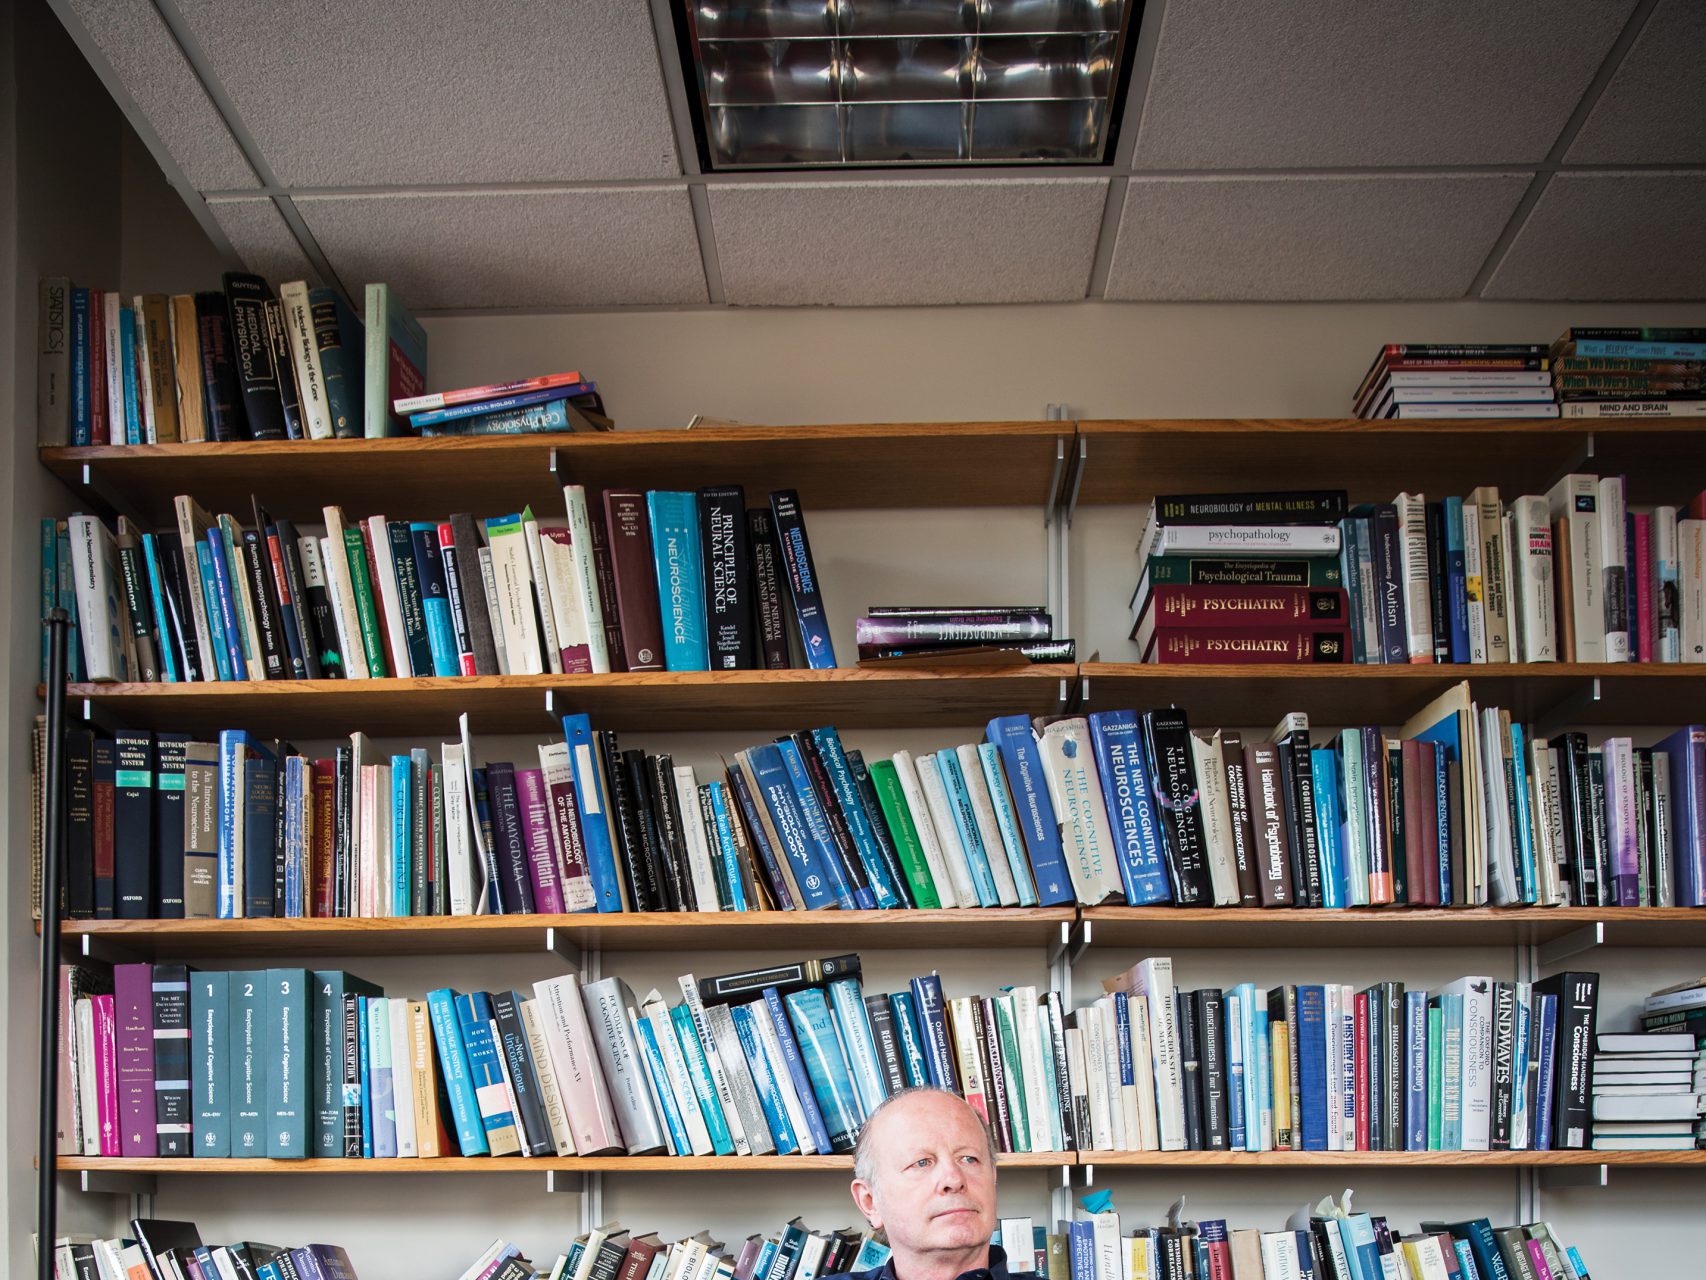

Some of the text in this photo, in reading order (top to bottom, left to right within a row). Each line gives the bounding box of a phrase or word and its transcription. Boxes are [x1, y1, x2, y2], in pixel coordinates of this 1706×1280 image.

[48, 286, 64, 349] STATISTICS
[232, 282, 260, 290] GUYTON
[235, 306, 252, 377] PHYSIOLOGY
[247, 307, 261, 354] MEDICAL
[296, 305, 307, 337] Molecular
[301, 339, 312, 362] Biology
[307, 363, 314, 371] of
[310, 384, 319, 402] Gene
[445, 408, 471, 417] MEDICAL
[490, 400, 516, 410] BIOLOGY
[1191, 501, 1315, 514] NEUROBIOLOGY of MENTAL ILLNESS
[1209, 530, 1291, 542] psychopathology
[86, 539, 97, 591] Neurochemistry
[120, 550, 137, 611] NEUROBIOLOGY
[667, 538, 685, 644] NEUROSCIENCE
[710, 507, 726, 613] NEURAL SCIENCE
[722, 514, 737, 604] PRINCIPLES OF
[790, 527, 814, 594] NEUROSCIENCE
[1199, 570, 1301, 583] Psychological Trauma
[1383, 534, 1398, 626] Understanding Autism
[250, 544, 274, 650] Human Neuropsychology Martin
[405, 557, 422, 630] Molecular Neurobiology
[756, 544, 765, 577] SCIENCE
[761, 602, 773, 642] BEHAVIOR
[764, 544, 775, 591] ESSENTIALS
[771, 605, 782, 640] NEURAL
[1203, 599, 1286, 610] PSYCHIATRY
[1207, 640, 1289, 651] PSYCHIATRY
[203, 771, 212, 832] An Introduction
[826, 737, 856, 805] Biological Psychology
[1017, 747, 1044, 841] The Cognitive Neurosciences
[1236, 765, 1247, 809] HANDBOOK
[191, 796, 199, 849] Neurosciences
[501, 784, 523, 882] THE AMYGDALA
[557, 796, 573, 864] OF THE AMYGDALA
[566, 793, 582, 865] THE NEUROBIOLOGY
[1063, 769, 1091, 879] NEUROSCIENCES
[1076, 768, 1102, 876] THE COGNITIVE
[1110, 745, 1143, 867] NEUROSCIENCES
[1127, 743, 1158, 864] THE NEW COGNITIVE
[1177, 746, 1200, 869] THE COGNITIVE
[1228, 765, 1246, 871] COGNITIVE NEUROSCIENCE
[1262, 768, 1284, 880] Handbook of Psychobiology
[1301, 780, 1319, 887] COGNITIVE NEUROSCIENCE
[718, 814, 738, 884] Brain Architecture
[244, 984, 253, 997] 2
[281, 981, 289, 995] 3
[323, 984, 332, 997] 4
[324, 1009, 332, 1045] Encyclopedia
[768, 994, 796, 1061] The Noisy Brain
[935, 1021, 953, 1085] Oxford Handbook
[1205, 1001, 1218, 1061] Consciousness
[1413, 1007, 1425, 1091] Conscious Experience
[1469, 999, 1477, 1087] CONSCIOUSNESS
[1496, 988, 1512, 1083] MINDWAVES
[1571, 1026, 1581, 1091] Consciousness
[282, 1053, 290, 1079] Cognitive
[504, 1033, 525, 1093] Unconscious
[530, 1033, 563, 1128] MIND DESIGN
[881, 1030, 901, 1089] READING IN THE
[1208, 1071, 1219, 1088] Four
[1210, 1091, 1220, 1130] Dimensions
[1540, 1241, 1563, 1280] SOCIAL
